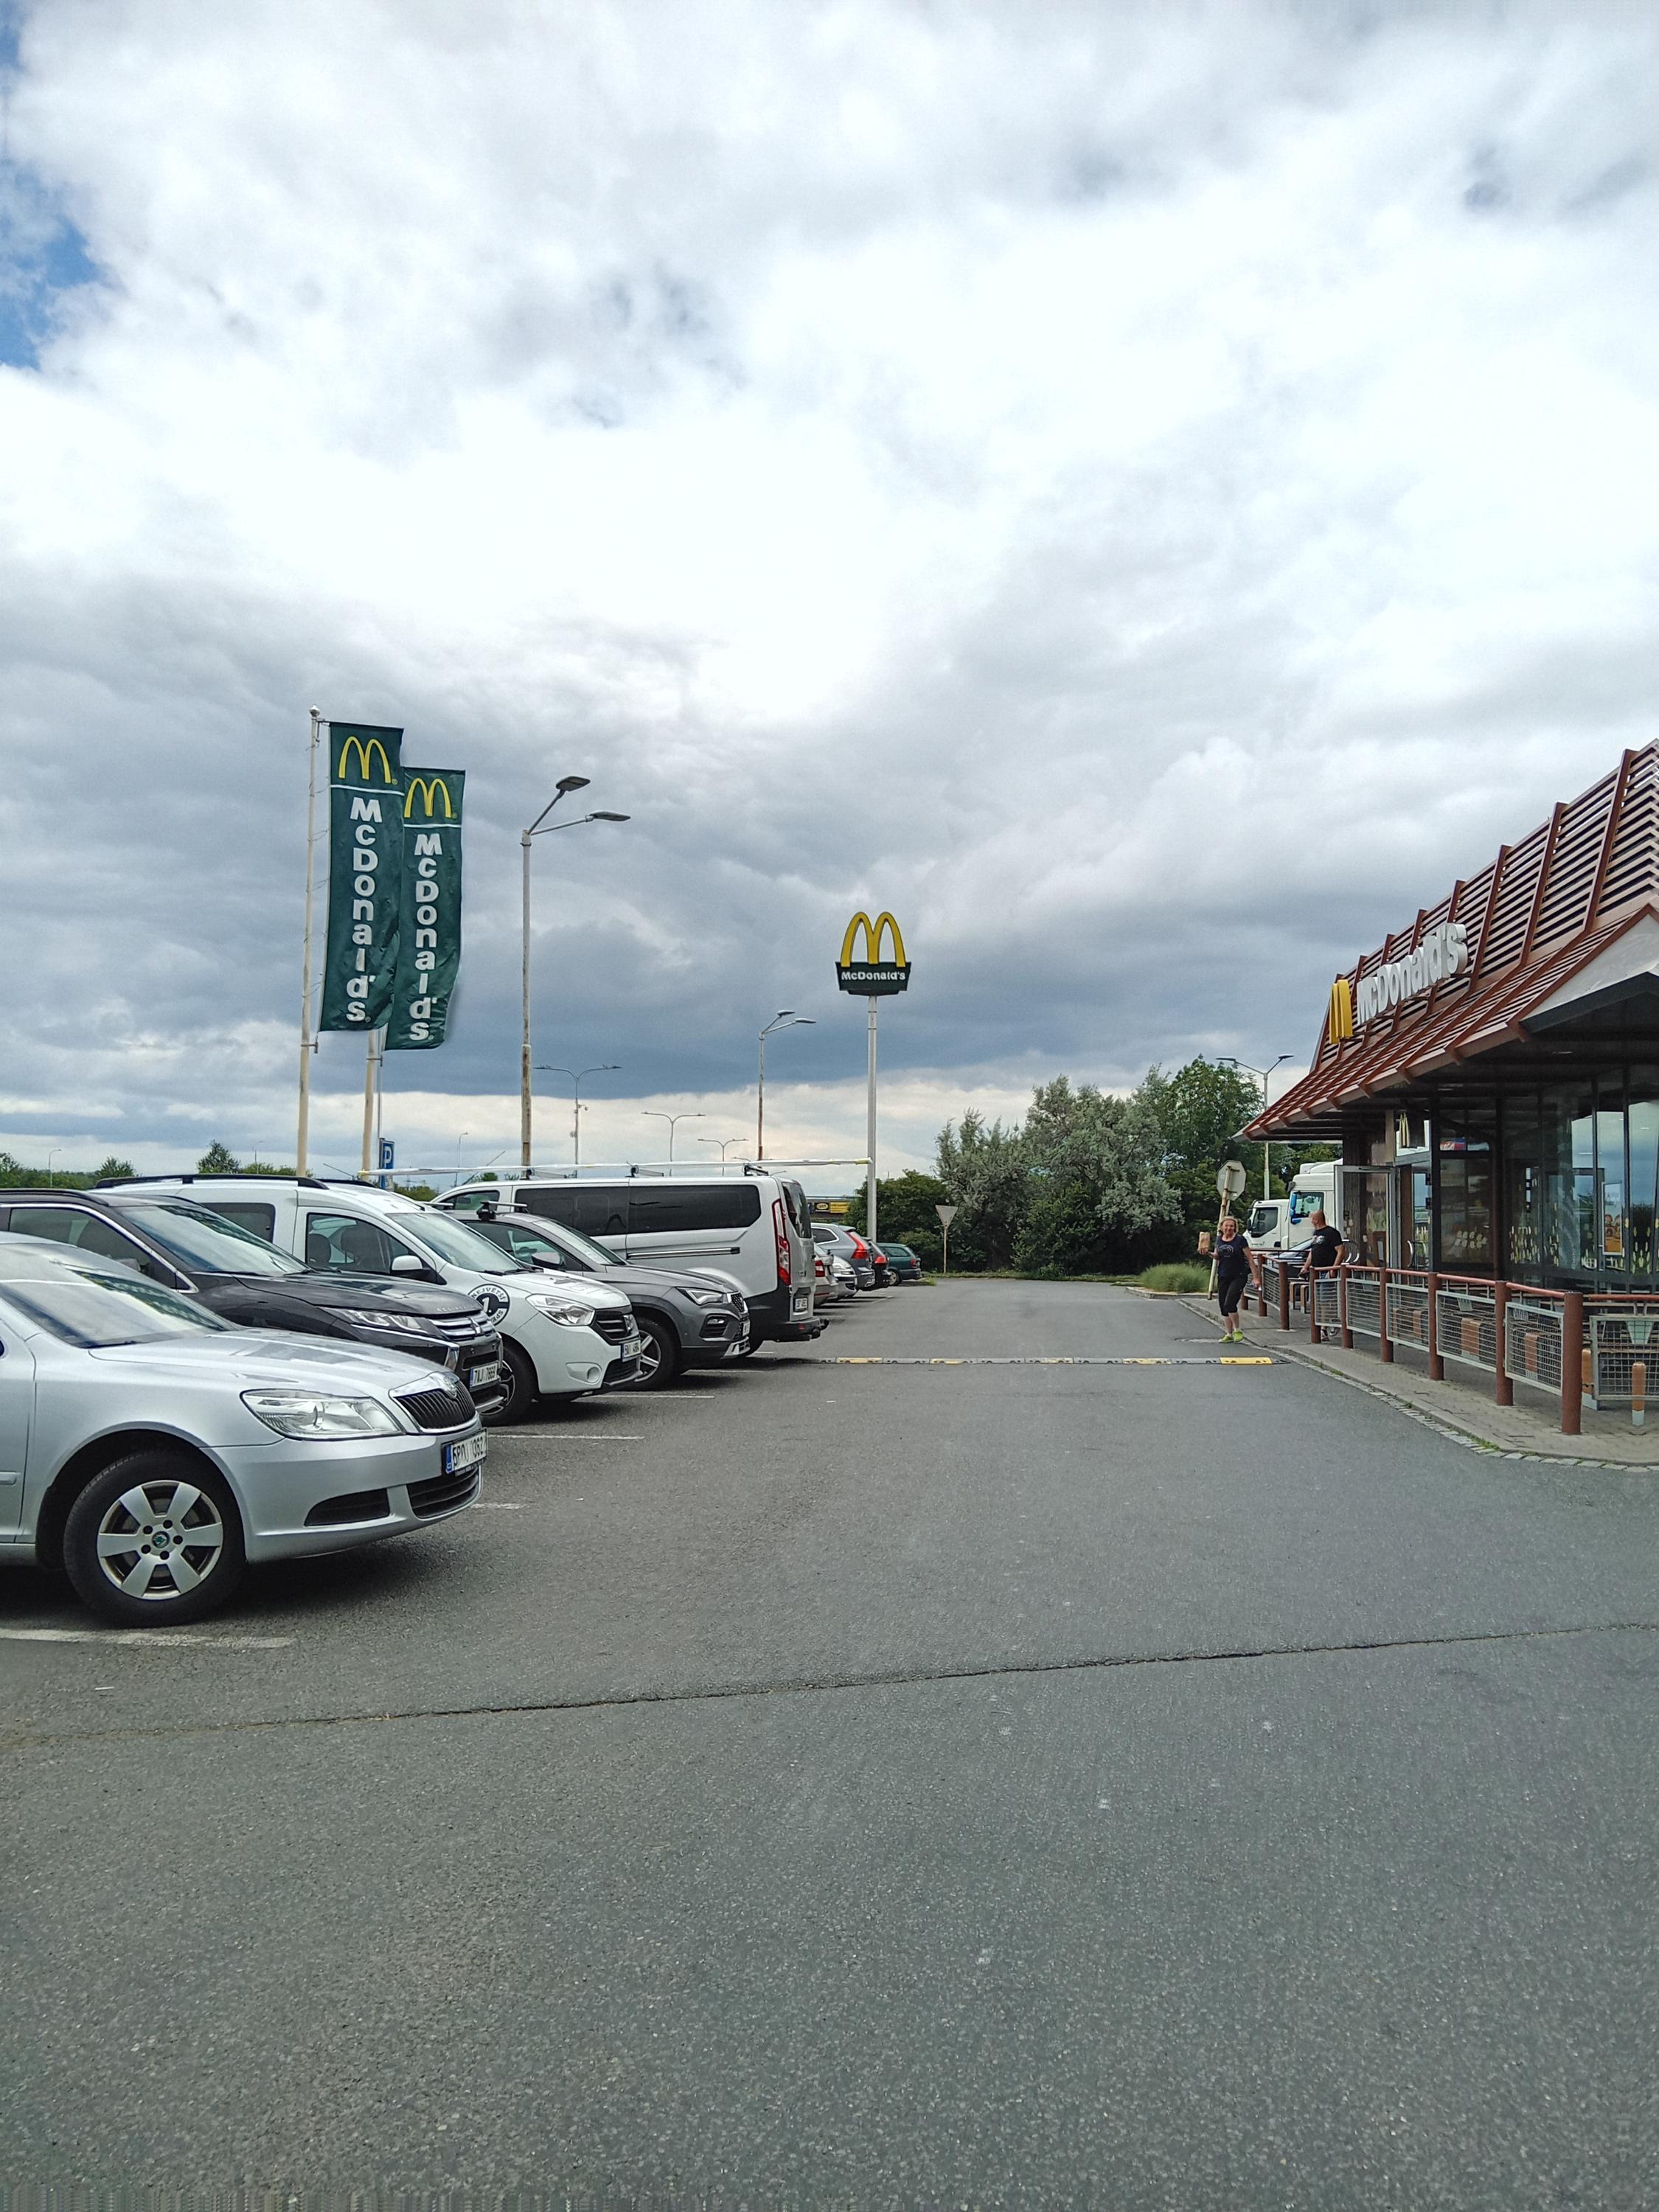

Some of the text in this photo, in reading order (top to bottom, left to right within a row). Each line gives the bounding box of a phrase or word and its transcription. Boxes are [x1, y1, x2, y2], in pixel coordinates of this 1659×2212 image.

[346, 796, 382, 1023] McDonald's
[409, 832, 442, 1041] McDonald's
[841, 971, 906, 981] McDonald's
[1357, 923, 1469, 1026] McDonald's
